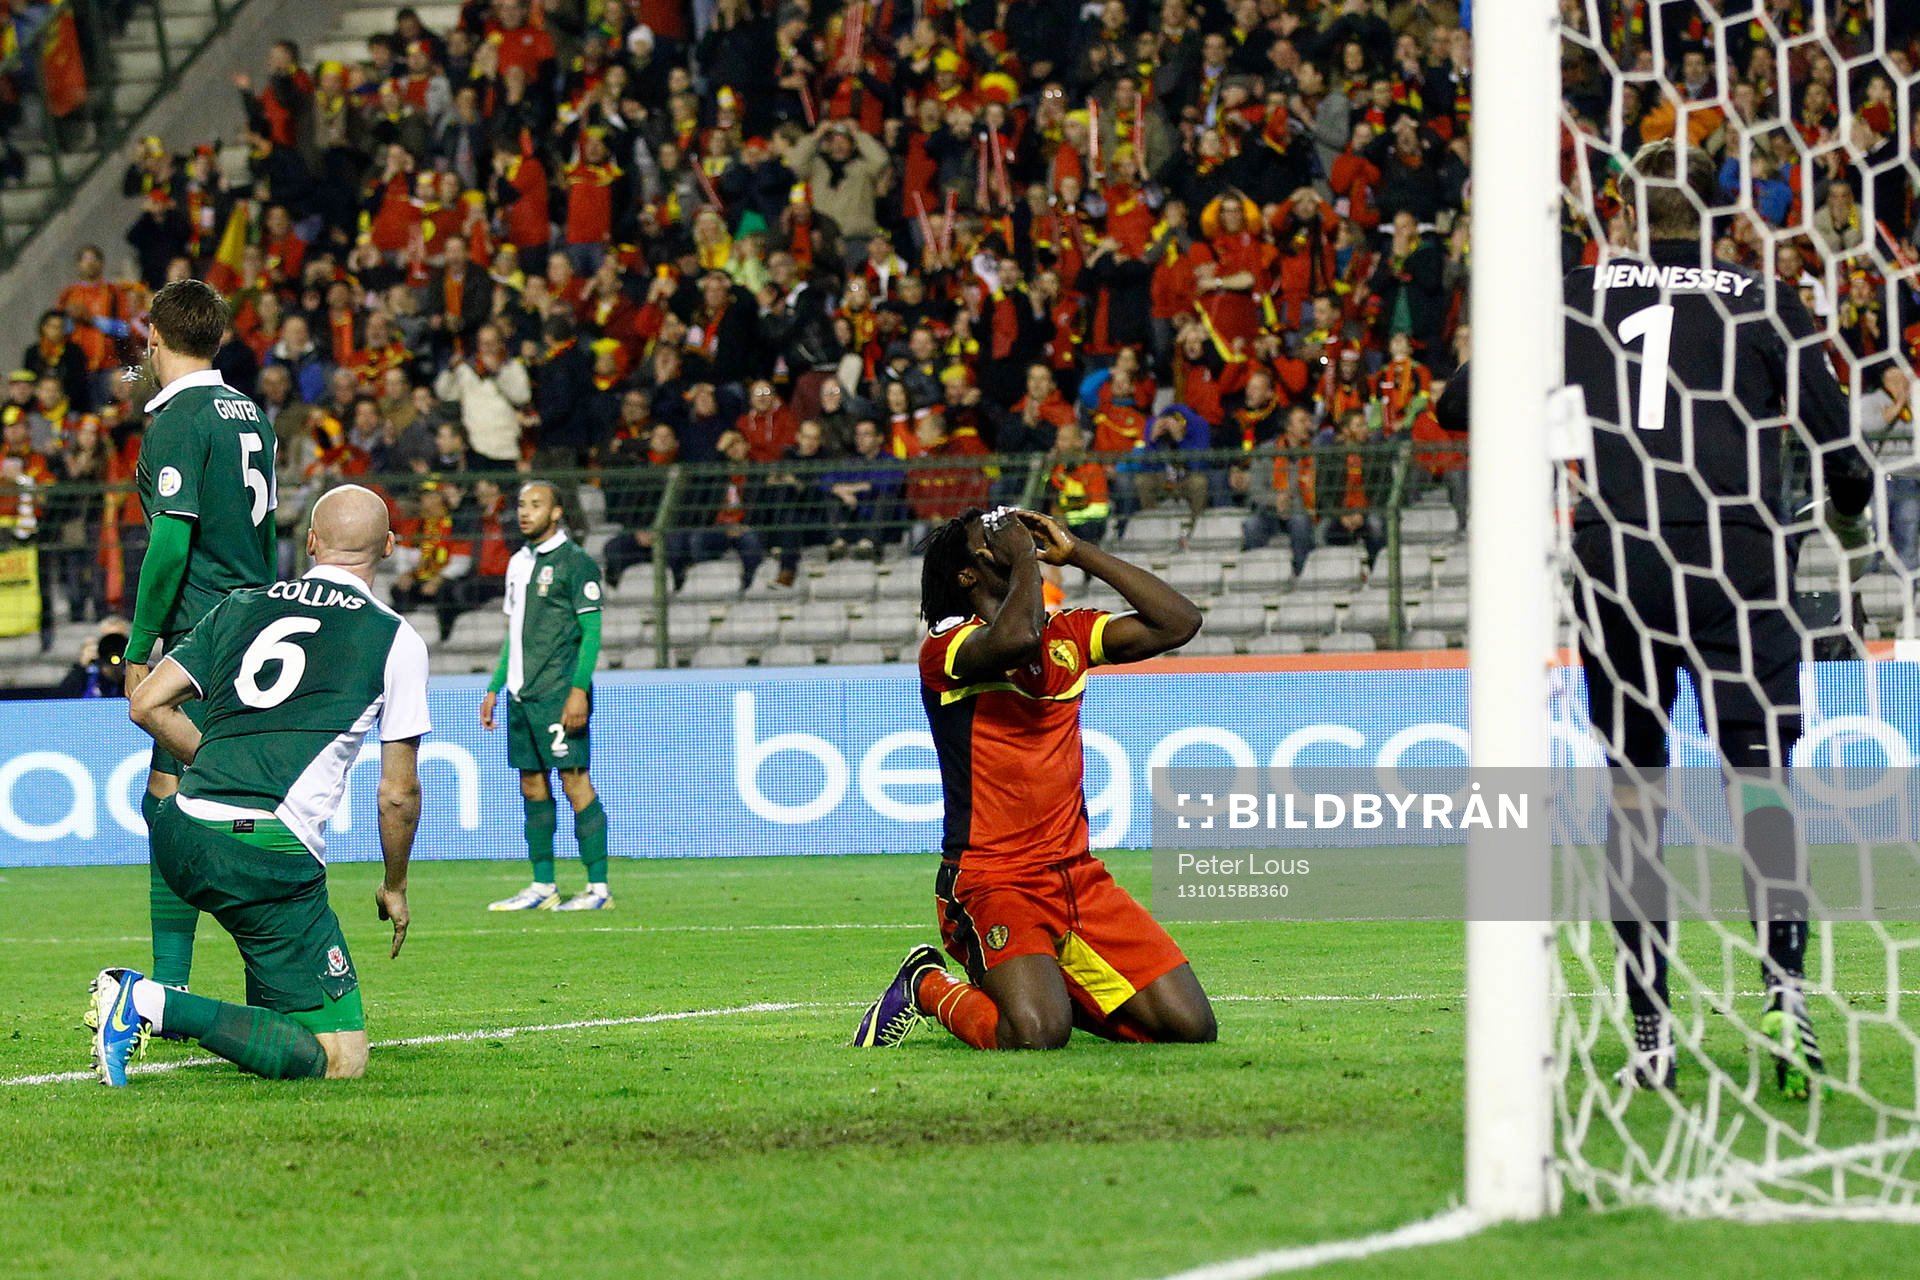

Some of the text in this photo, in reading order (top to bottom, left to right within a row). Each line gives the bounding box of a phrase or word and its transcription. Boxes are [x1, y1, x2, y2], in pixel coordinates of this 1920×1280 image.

[1593, 264, 1752, 297] HENNESSEY
[1618, 303, 1674, 430] 1
[239, 432, 268, 527] 5
[267, 580, 367, 610] COLLINS
[233, 616, 321, 709] 6
[548, 723, 568, 751] 2
